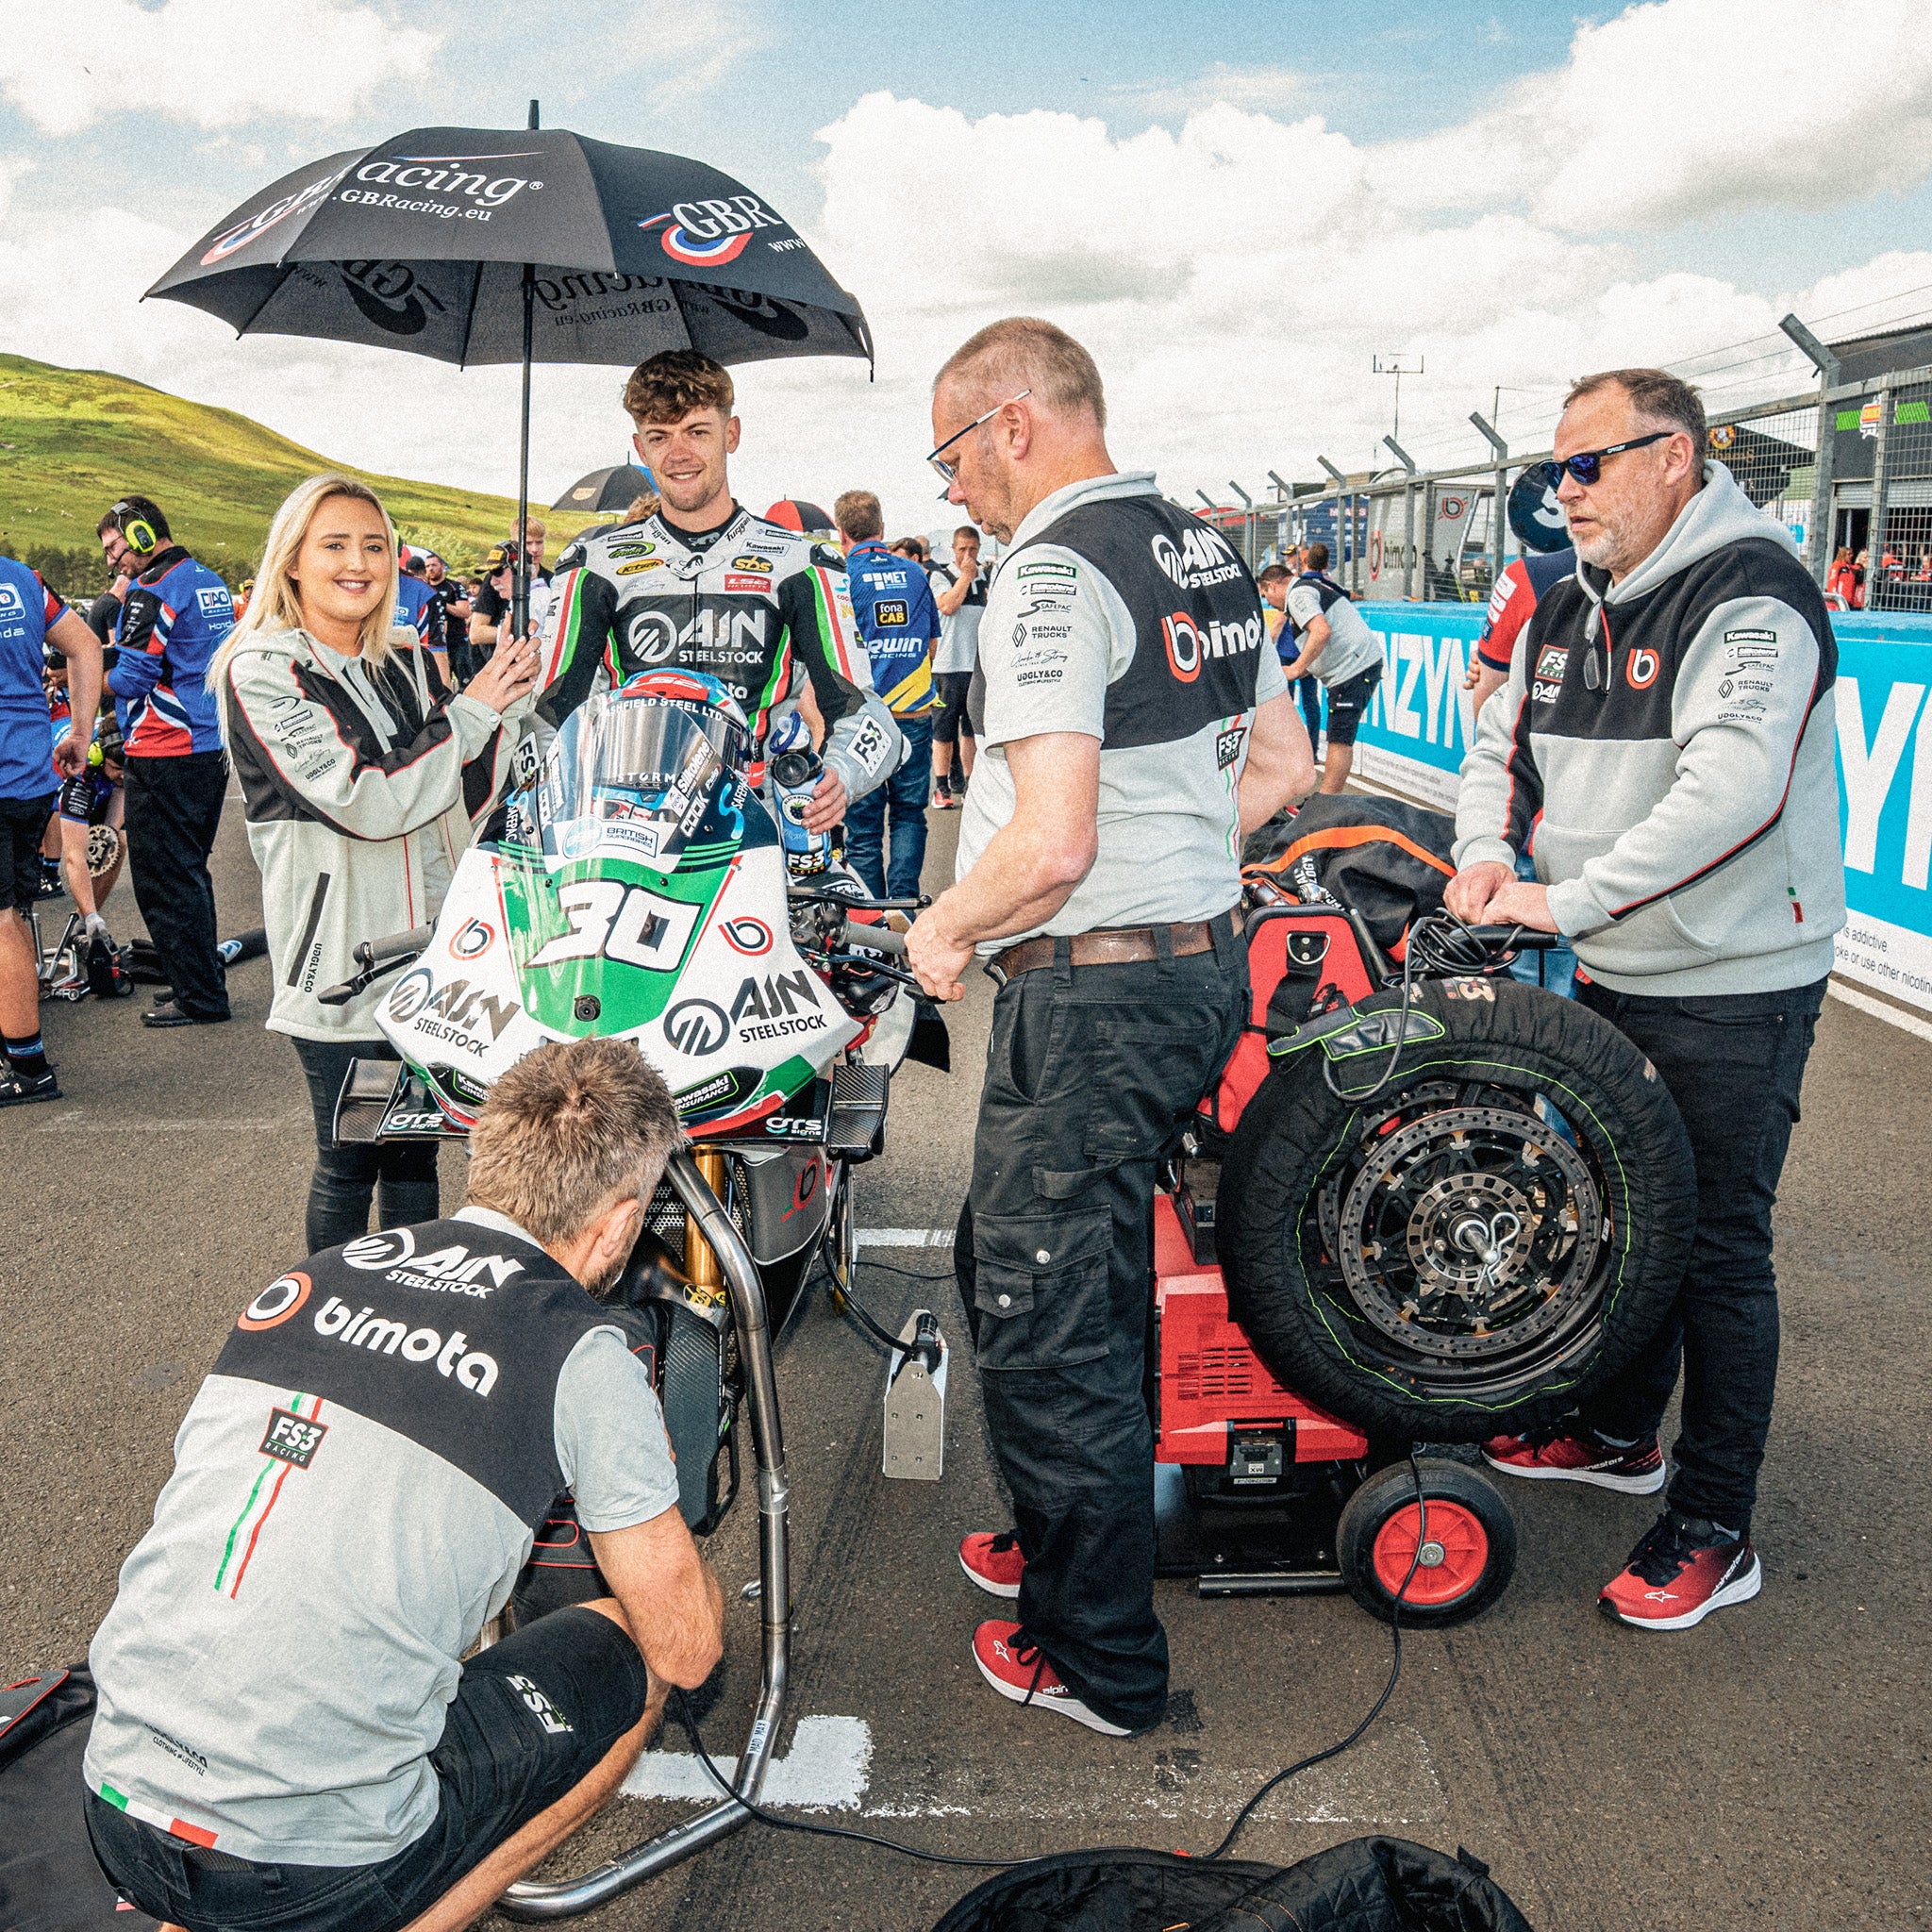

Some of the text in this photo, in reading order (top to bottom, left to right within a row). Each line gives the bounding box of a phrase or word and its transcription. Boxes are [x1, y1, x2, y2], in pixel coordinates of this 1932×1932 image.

[673, 195, 784, 239] GBR
[746, 541, 785, 551] Kawasaki
[882, 572, 907, 584] MET
[879, 613, 905, 624] CAB
[880, 604, 903, 613] fona
[1726, 630, 1774, 641] Kawasaki
[678, 650, 764, 664] STEELSTOCK
[1738, 680, 1774, 689] RENAULT
[659, 698, 699, 713] STEEL
[702, 706, 723, 722] LTD
[607, 827, 654, 844] BRITISH
[525, 879, 705, 973] 30
[1835, 943, 1849, 960] oke
[1851, 952, 1859, 964] or
[1861, 956, 1875, 972] use
[1877, 962, 1900, 981] other
[413, 1017, 490, 1058] STEELSTOCK
[739, 1014, 828, 1043] STEELSTOCK
[674, 1074, 730, 1106] awasaki
[385, 1269, 494, 1300] STEELSTOCK
[313, 1295, 500, 1398] bimota
[264, 1442, 307, 1463] RACING
[153, 1736, 178, 1757] CLOTHING
[181, 1755, 206, 1776] LIFESTYLE
